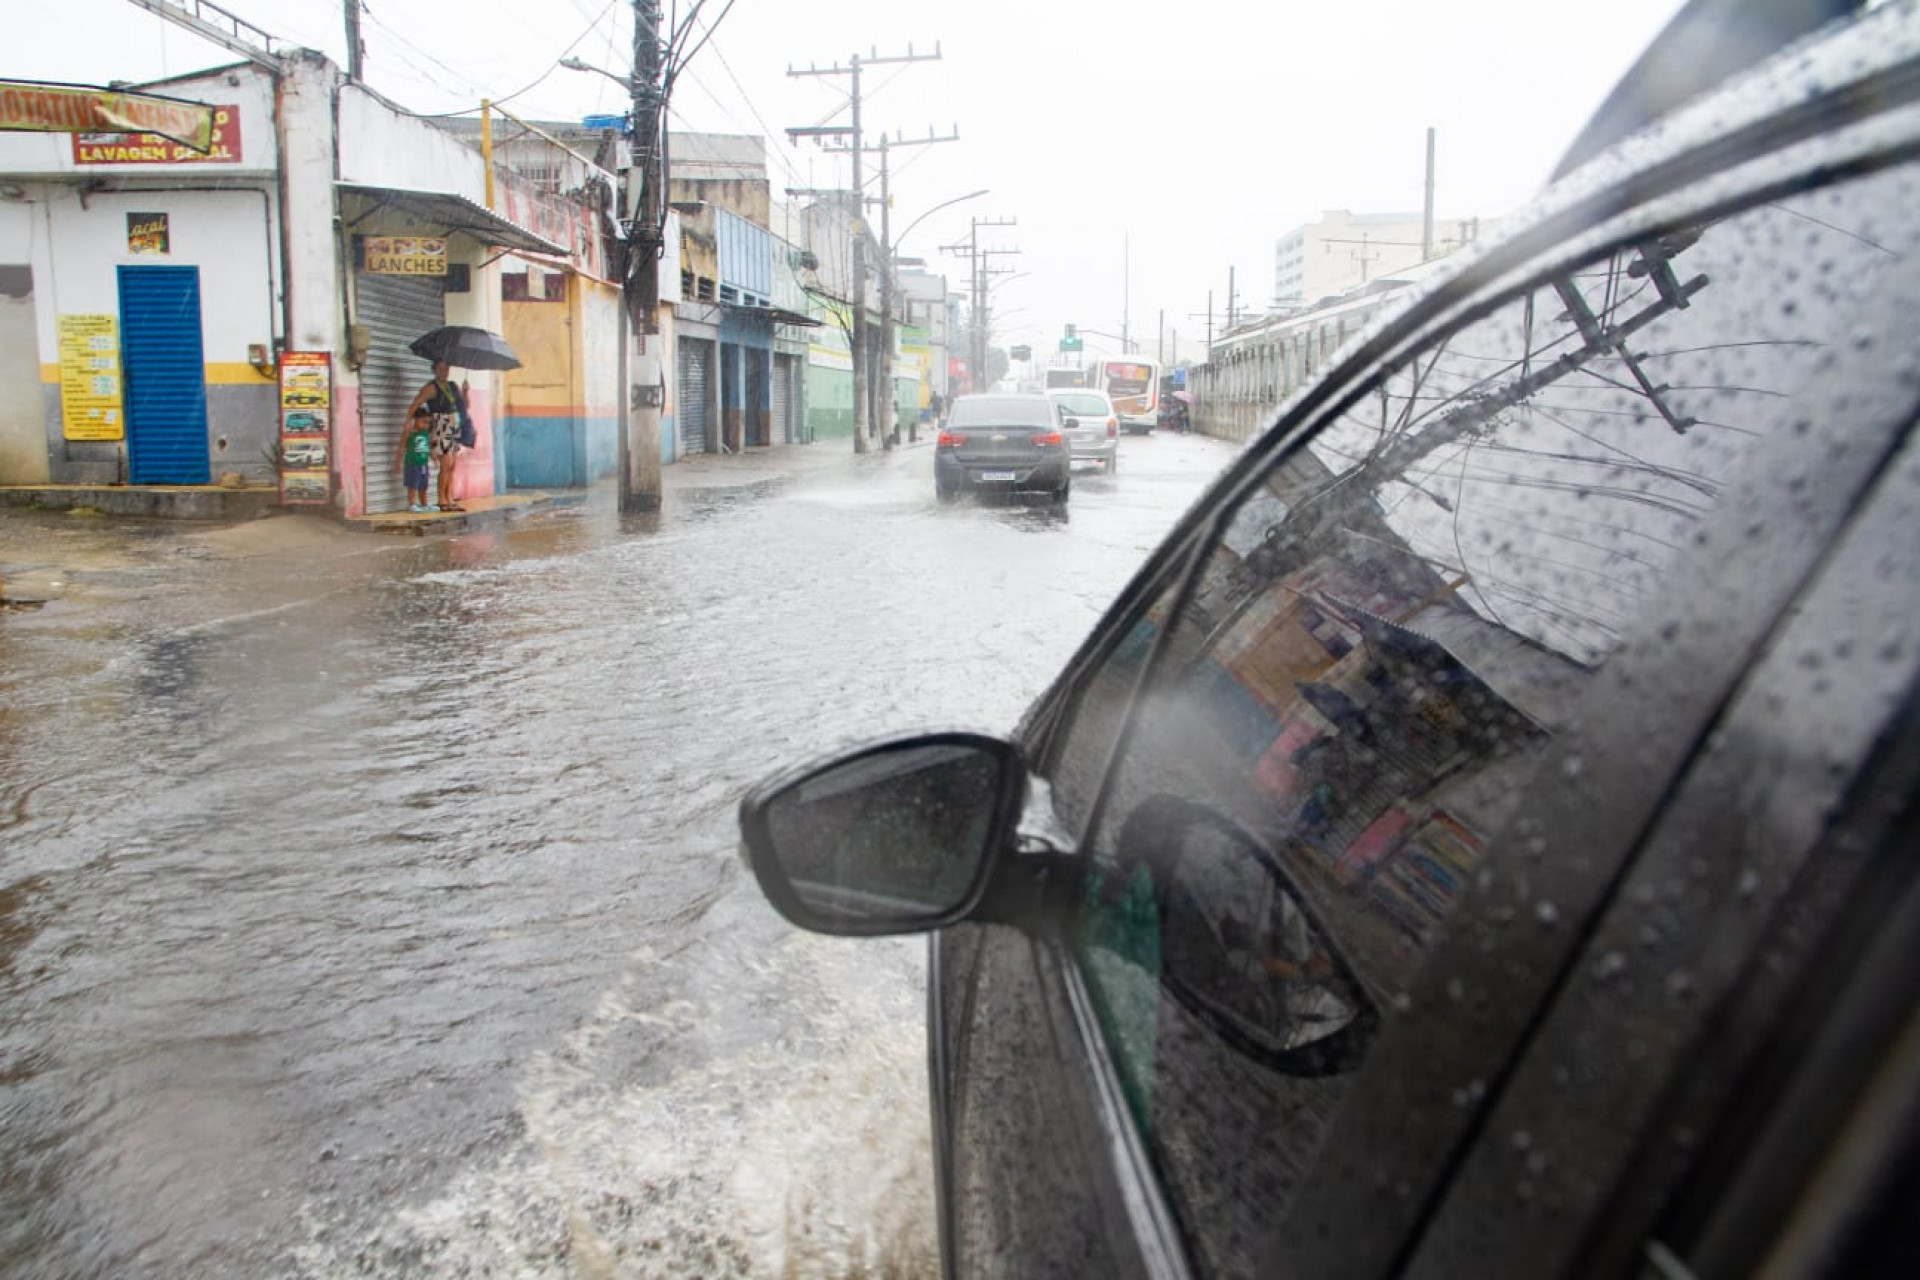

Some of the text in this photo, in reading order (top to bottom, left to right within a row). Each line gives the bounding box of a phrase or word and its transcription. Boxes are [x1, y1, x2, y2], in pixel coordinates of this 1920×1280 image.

[0, 89, 109, 128] OTATIVO
[80, 145, 232, 160] LAVAGEM GEAL
[367, 258, 445, 272] LANCHES
